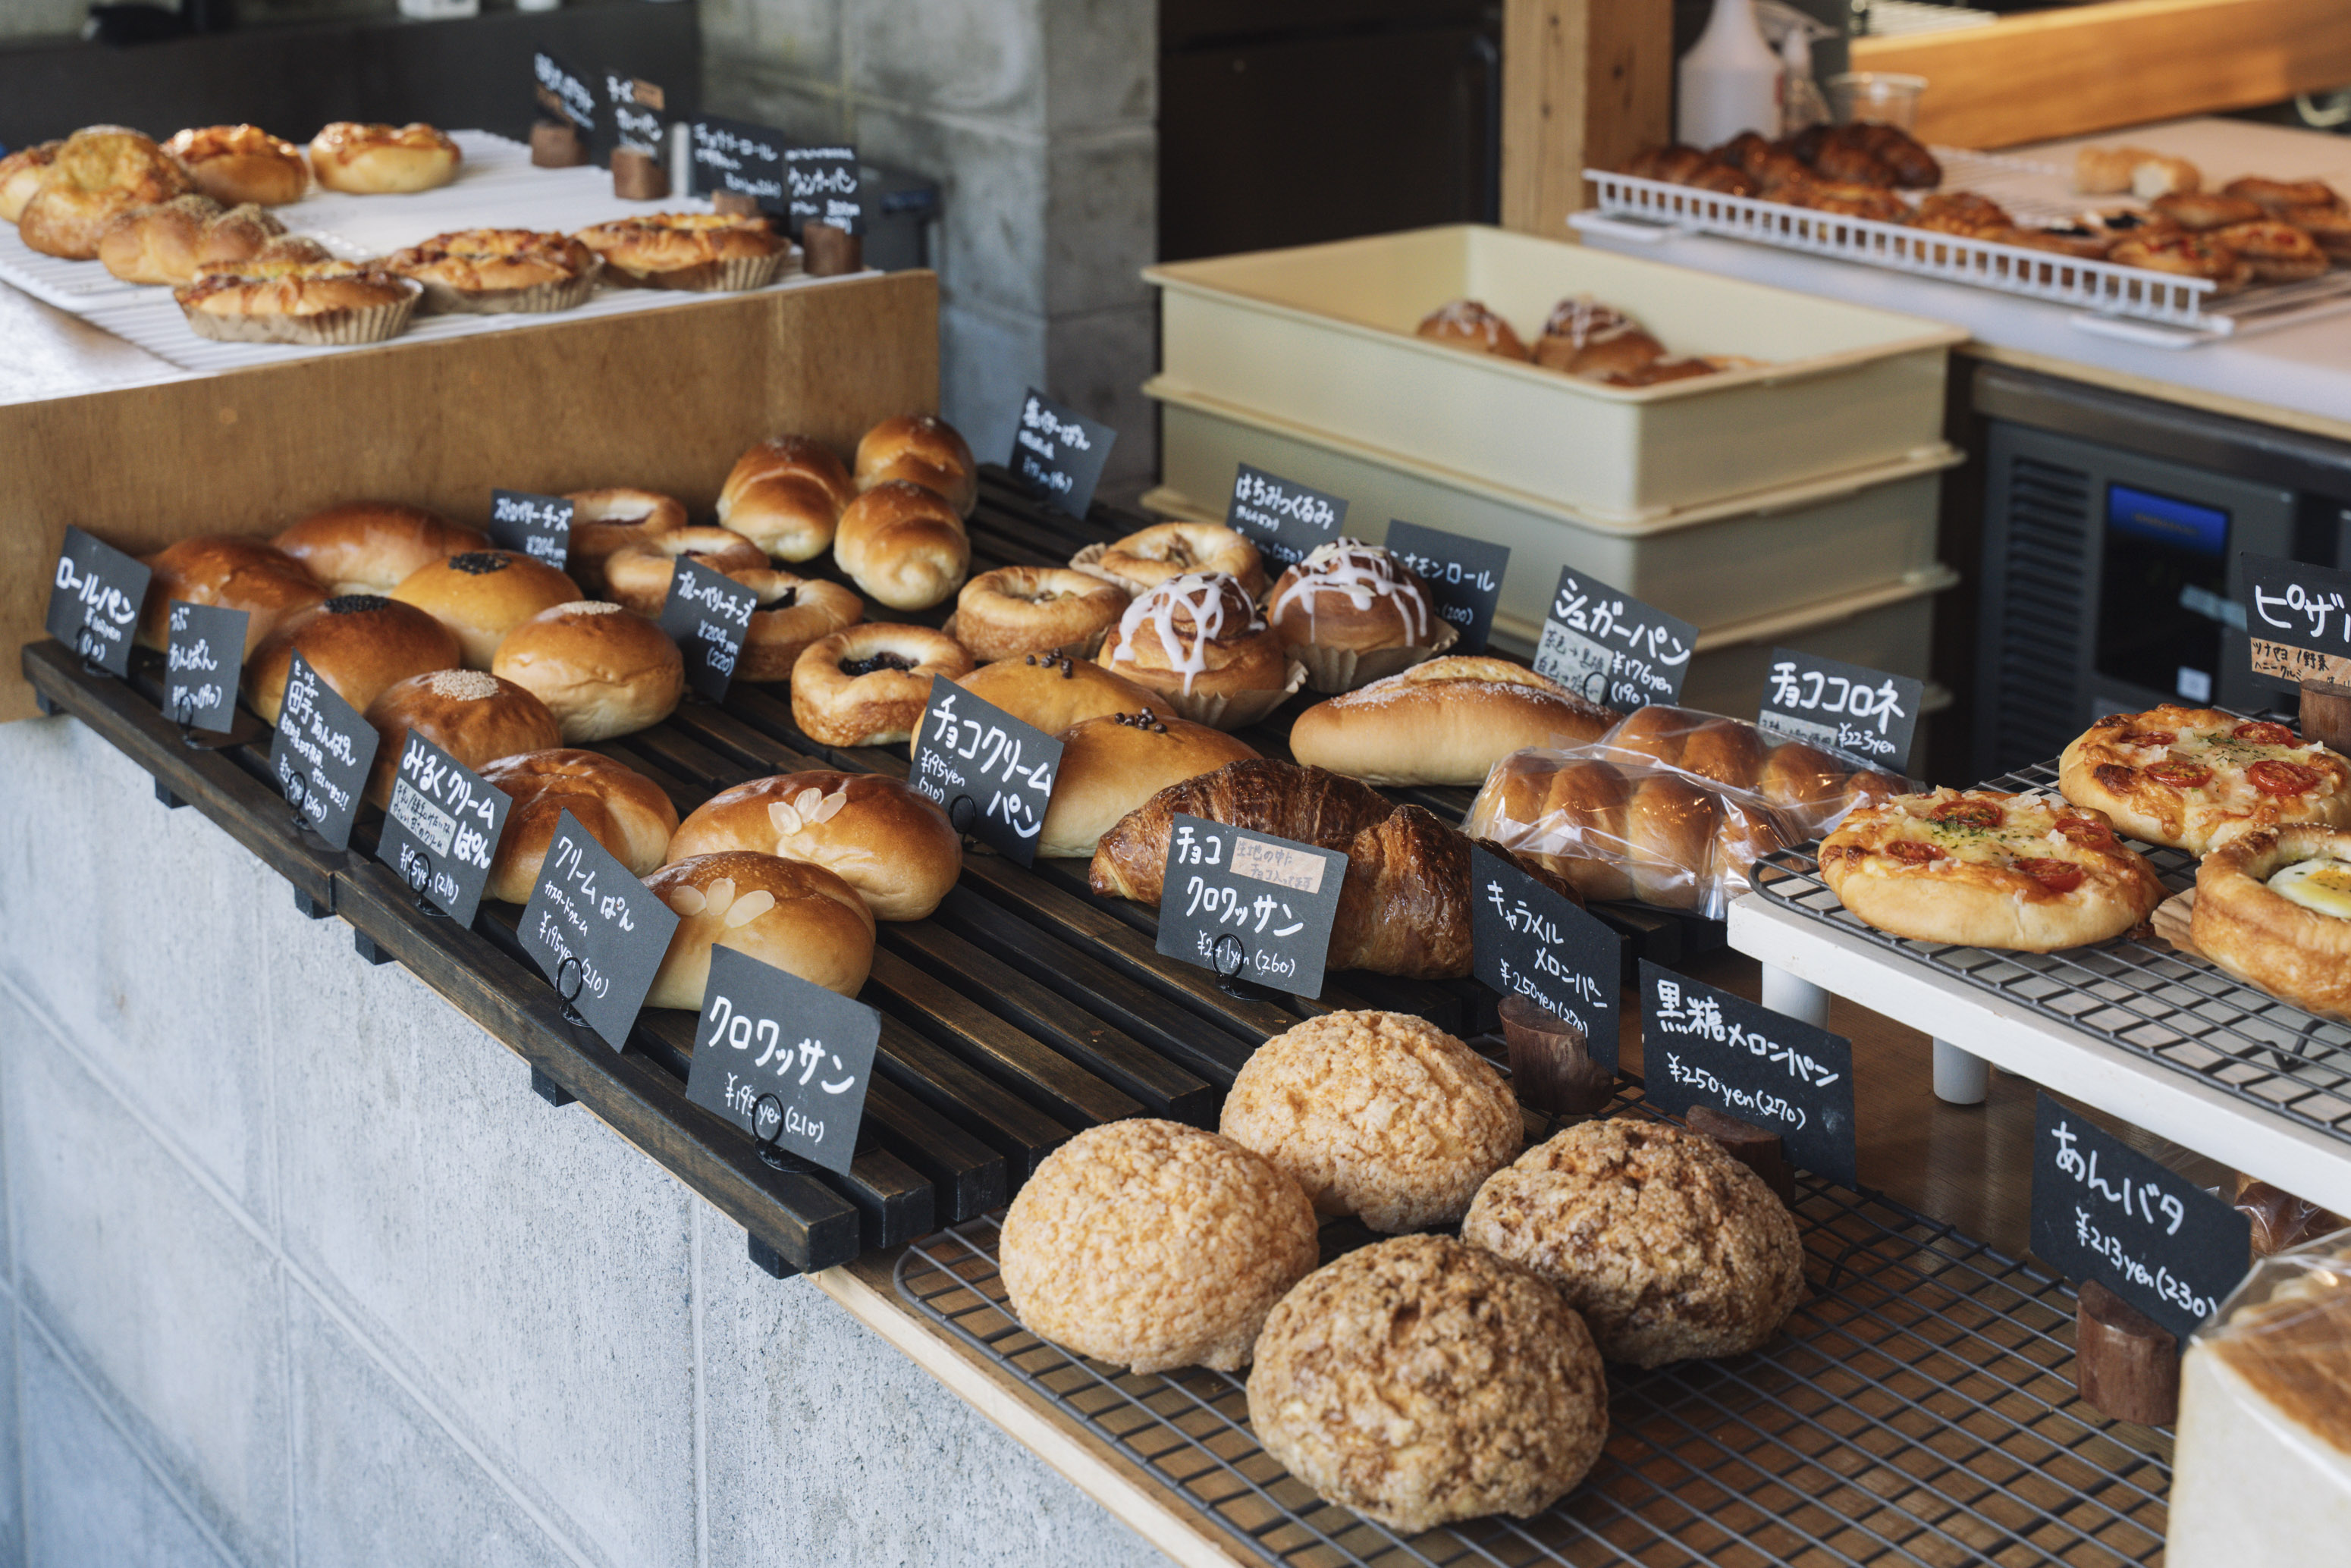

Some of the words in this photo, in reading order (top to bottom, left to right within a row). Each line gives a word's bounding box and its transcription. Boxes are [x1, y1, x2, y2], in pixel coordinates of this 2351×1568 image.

[55, 556, 135, 624] ロールパン
[677, 570, 757, 627] ブルーベリーチーズ
[1389, 550, 1496, 592] ナモンロール
[1555, 578, 1690, 666] シュガーパン
[1612, 651, 1672, 695] ¥176yen
[1770, 662, 1905, 735] チョココロネ
[921, 746, 965, 787] ¥195yen
[933, 694, 1051, 797] チョコクリーム
[1838, 722, 1896, 755] ¥223yen
[403, 739, 494, 829] みるくクリーム
[987, 790, 1041, 838] パン
[454, 821, 491, 870] ぱん
[1176, 826, 1221, 864] チョコ
[435, 871, 459, 905] (210)
[555, 836, 634, 932] クリームぱん
[1185, 876, 1304, 937] クロワッサン
[1487, 880, 1564, 944] キャラメル
[580, 958, 609, 999] (210)
[1256, 949, 1295, 977] (260)
[1534, 947, 1608, 1008] メロンパン
[708, 995, 855, 1094] クロワッサン
[1656, 979, 1839, 1087] 黒糖メロンパン
[785, 1105, 824, 1143] (210)
[2051, 1121, 2184, 1236] あんバタ
